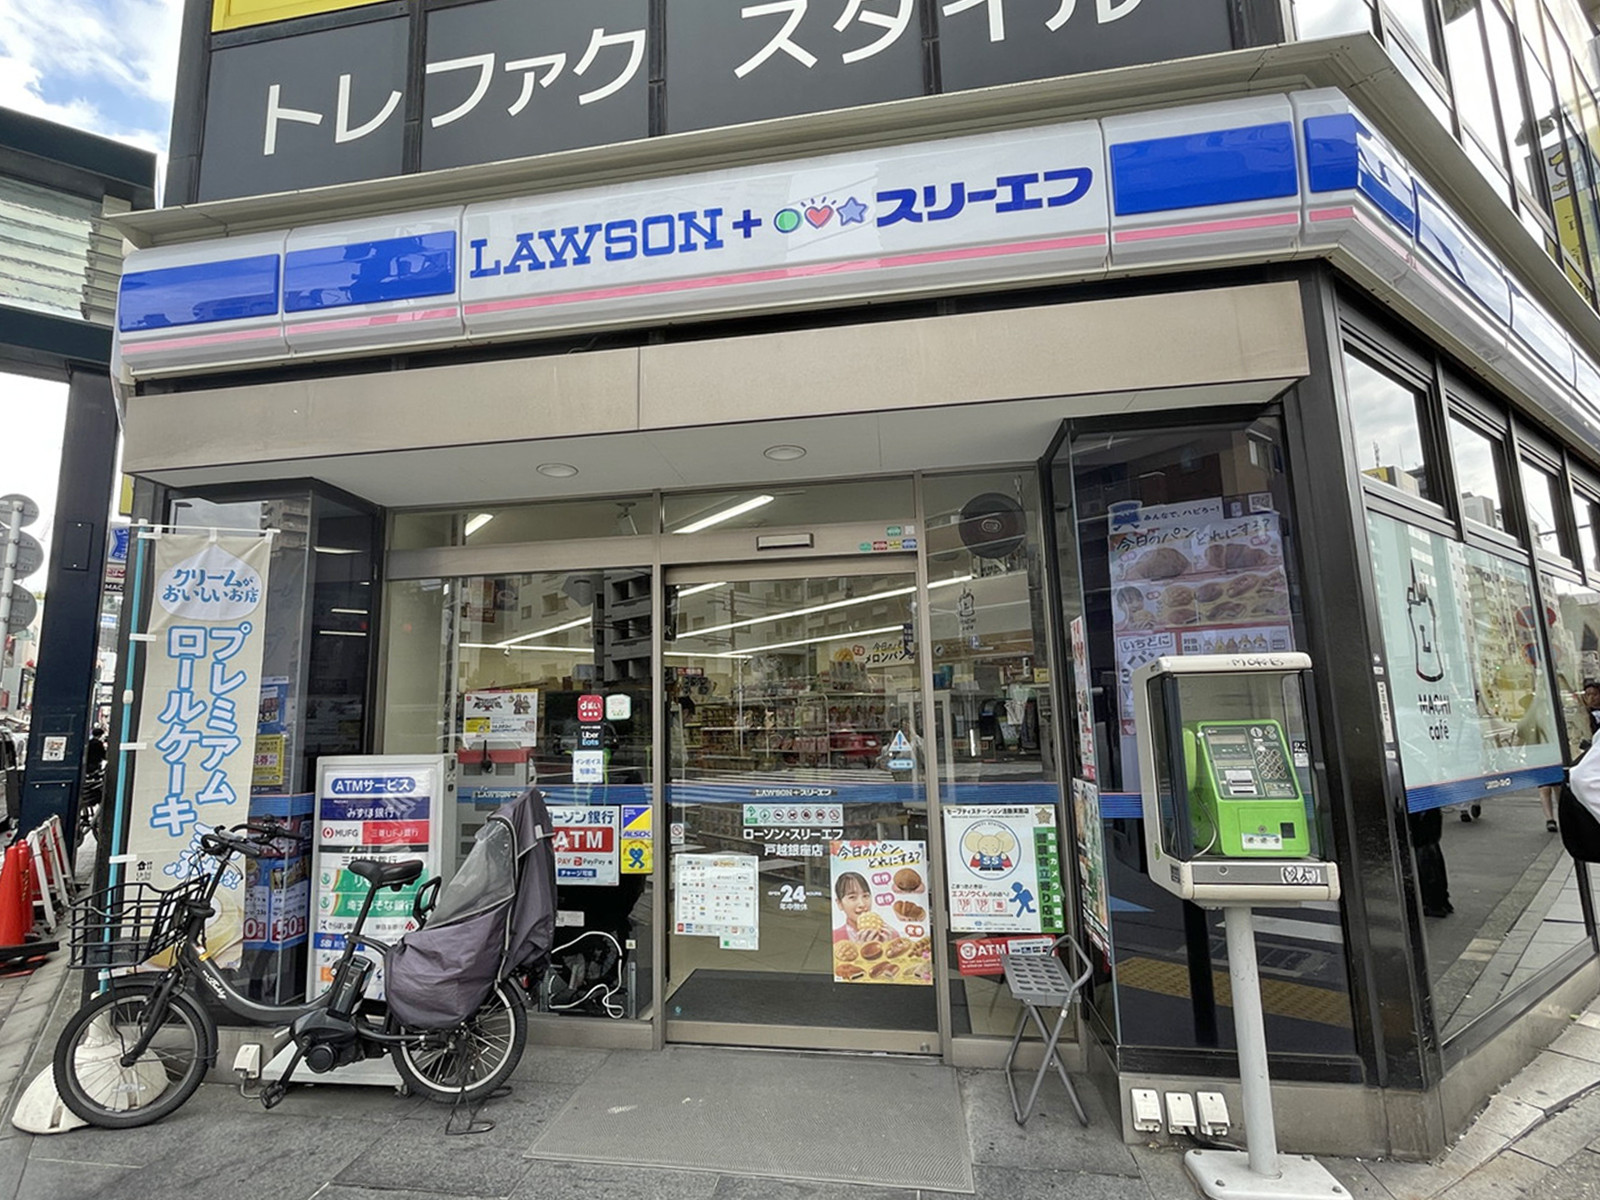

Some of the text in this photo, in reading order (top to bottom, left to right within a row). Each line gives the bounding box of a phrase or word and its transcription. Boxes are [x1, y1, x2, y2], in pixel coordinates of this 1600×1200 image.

[264, 28, 646, 156] トレファク
[469, 207, 724, 279] LAWSON
[876, 167, 1094, 228] スリーエフ
[173, 568, 254, 588] クリームが
[162, 586, 259, 604] おいしいお店
[195, 621, 253, 805] プレミアム
[150, 625, 208, 837] ロールケーキ
[582, 731, 599, 739] Uber
[335, 779, 411, 792] ATMサービス
[346, 806, 394, 819] みずほ銀行
[334, 829, 358, 837] MUFG
[553, 830, 603, 849] ATM
[743, 828, 844, 840] ローソン・スリーエフ
[764, 843, 823, 857] 戸越銀座店
[583, 857, 605, 865] PayPay
[780, 884, 806, 903] 24
[977, 943, 1006, 956] ATM
